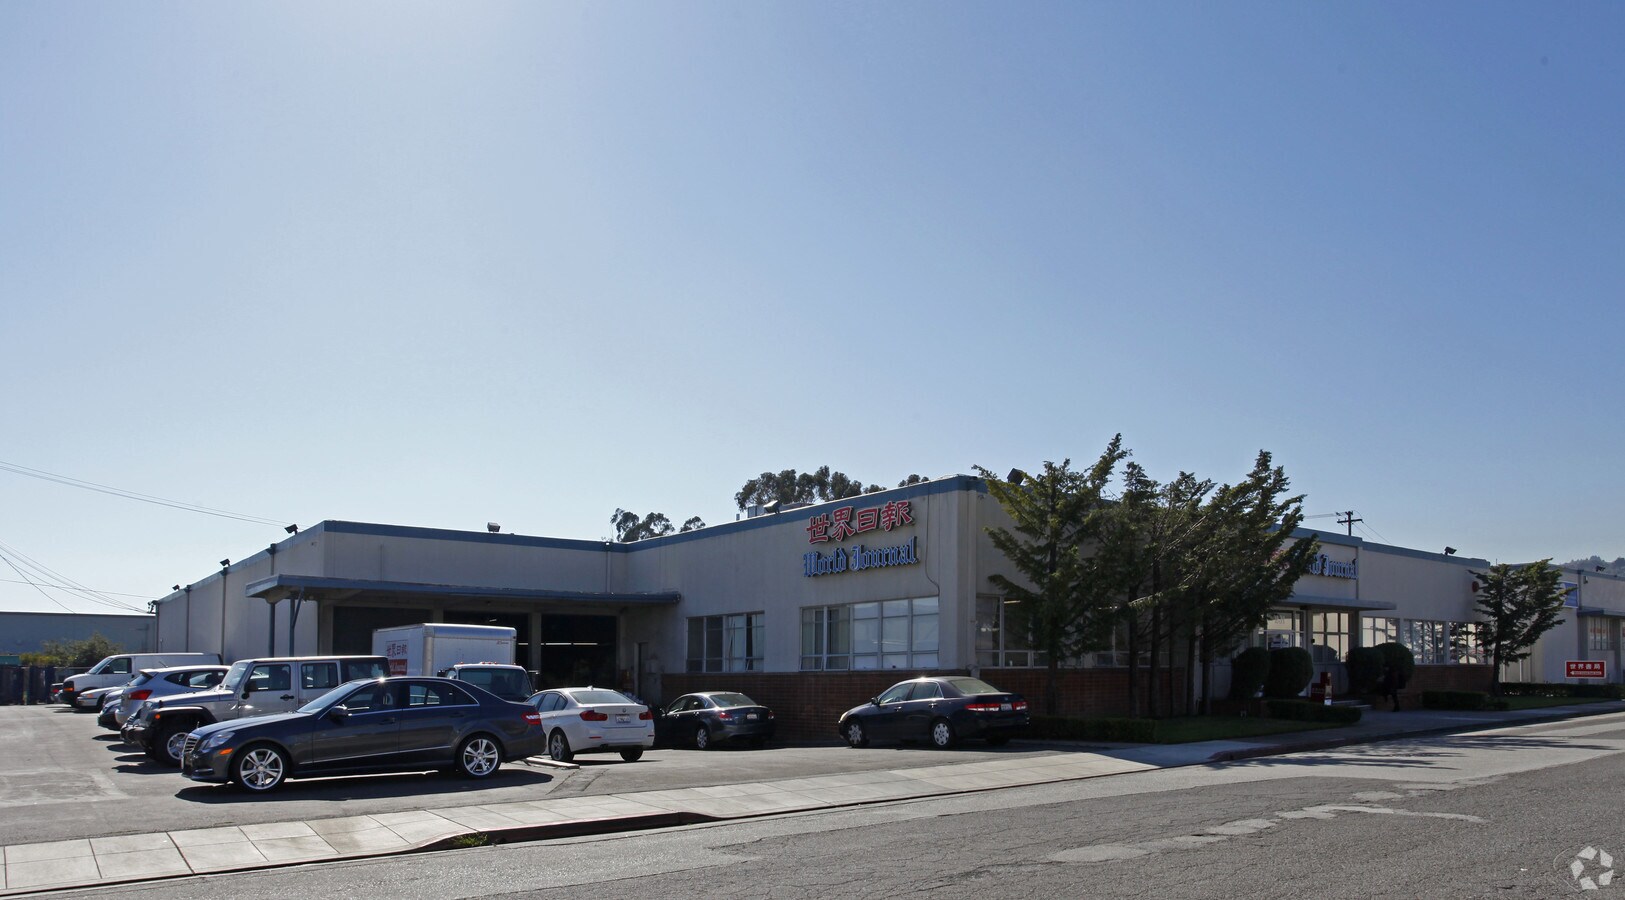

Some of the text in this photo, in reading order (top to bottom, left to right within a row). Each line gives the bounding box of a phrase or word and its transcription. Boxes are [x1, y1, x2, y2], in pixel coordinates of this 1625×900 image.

[806, 501, 913, 544] 世界日報
[803, 537, 918, 577] World Journal
[1322, 555, 1358, 579] Journal
